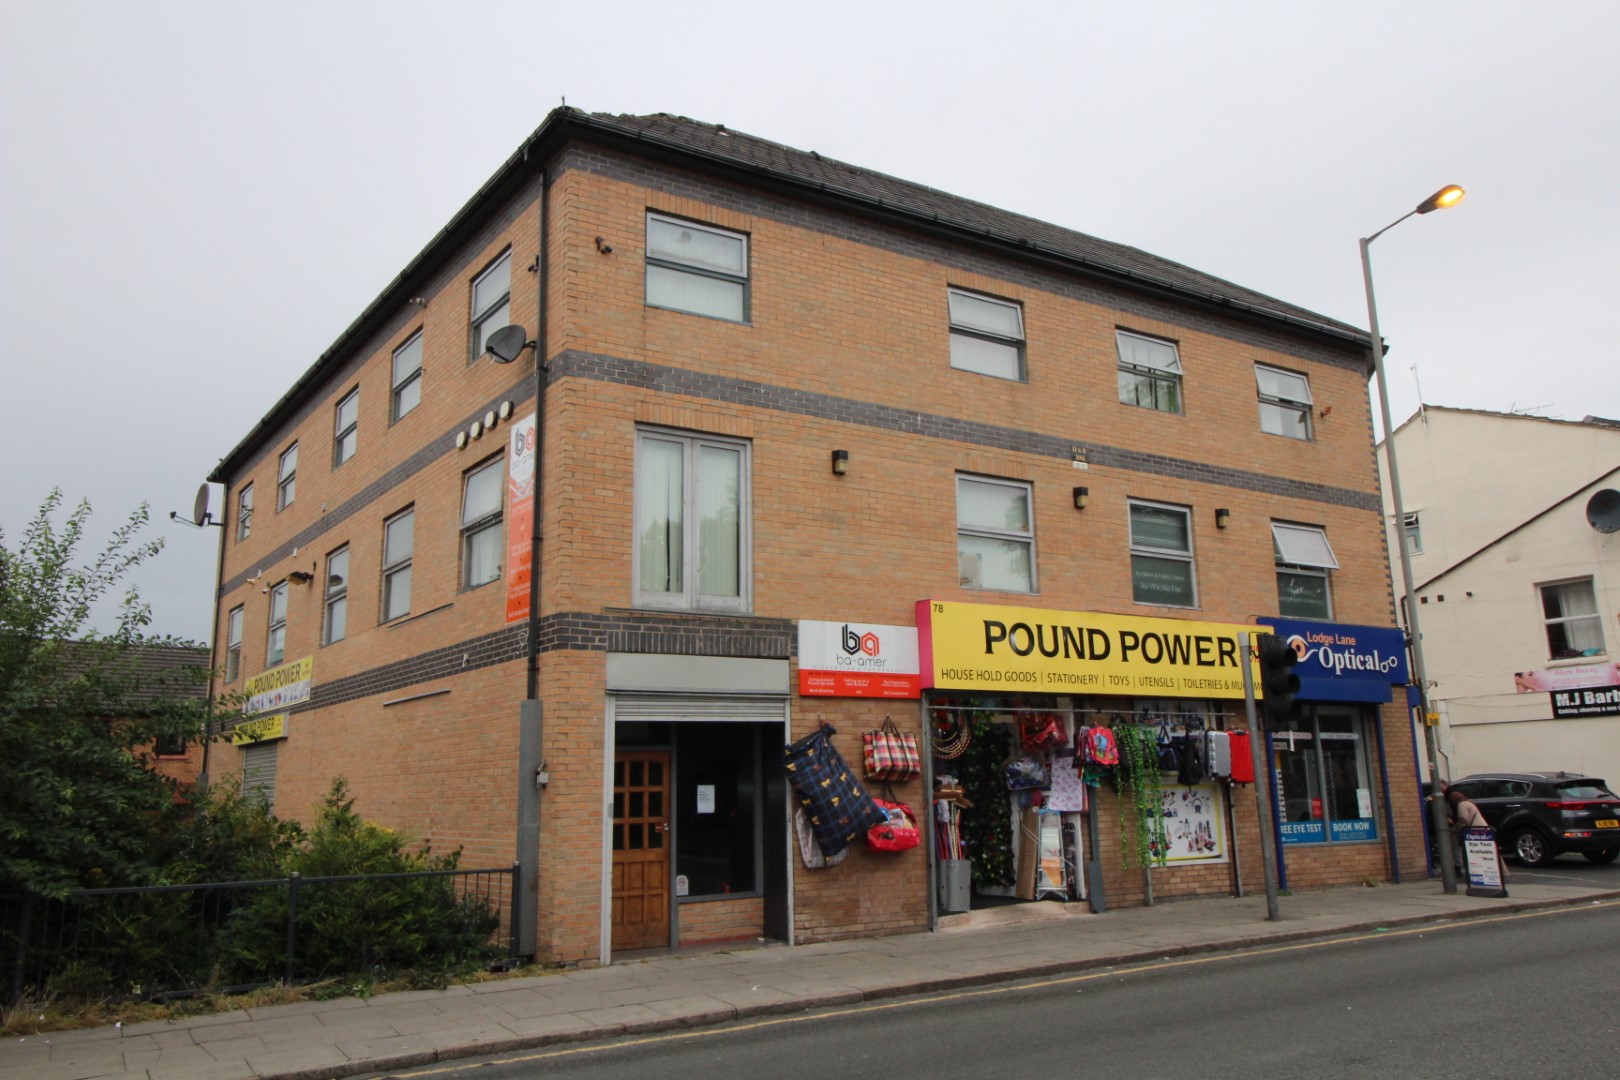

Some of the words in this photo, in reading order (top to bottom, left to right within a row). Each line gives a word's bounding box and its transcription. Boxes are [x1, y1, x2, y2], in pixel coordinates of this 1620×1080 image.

[933, 604, 944, 613] 78
[983, 620, 1111, 661] POUND
[1118, 630, 1238, 668] POWER
[1306, 631, 1334, 646] Lodge
[1335, 634, 1356, 646] Lane
[836, 653, 887, 667] ba-amer
[1318, 646, 1380, 675] Optical
[254, 672, 275, 696] POUND
[276, 663, 301, 688] POWER
[941, 668, 974, 680] HOUSE
[976, 670, 1002, 682] HOLD
[1004, 671, 1037, 682] GOODS
[1047, 672, 1100, 684] STATIONERY
[1108, 676, 1130, 686] TOYS
[1138, 677, 1174, 688] UTENSILS
[1183, 678, 1223, 690] TOILETRIES
[1224, 680, 1230, 690] &
[1555, 692, 1580, 707] M.J
[1293, 824, 1306, 834] EYE
[1306, 823, 1322, 832] TEST
[1332, 822, 1352, 832] BOOK
[1354, 822, 1370, 830] NOW
